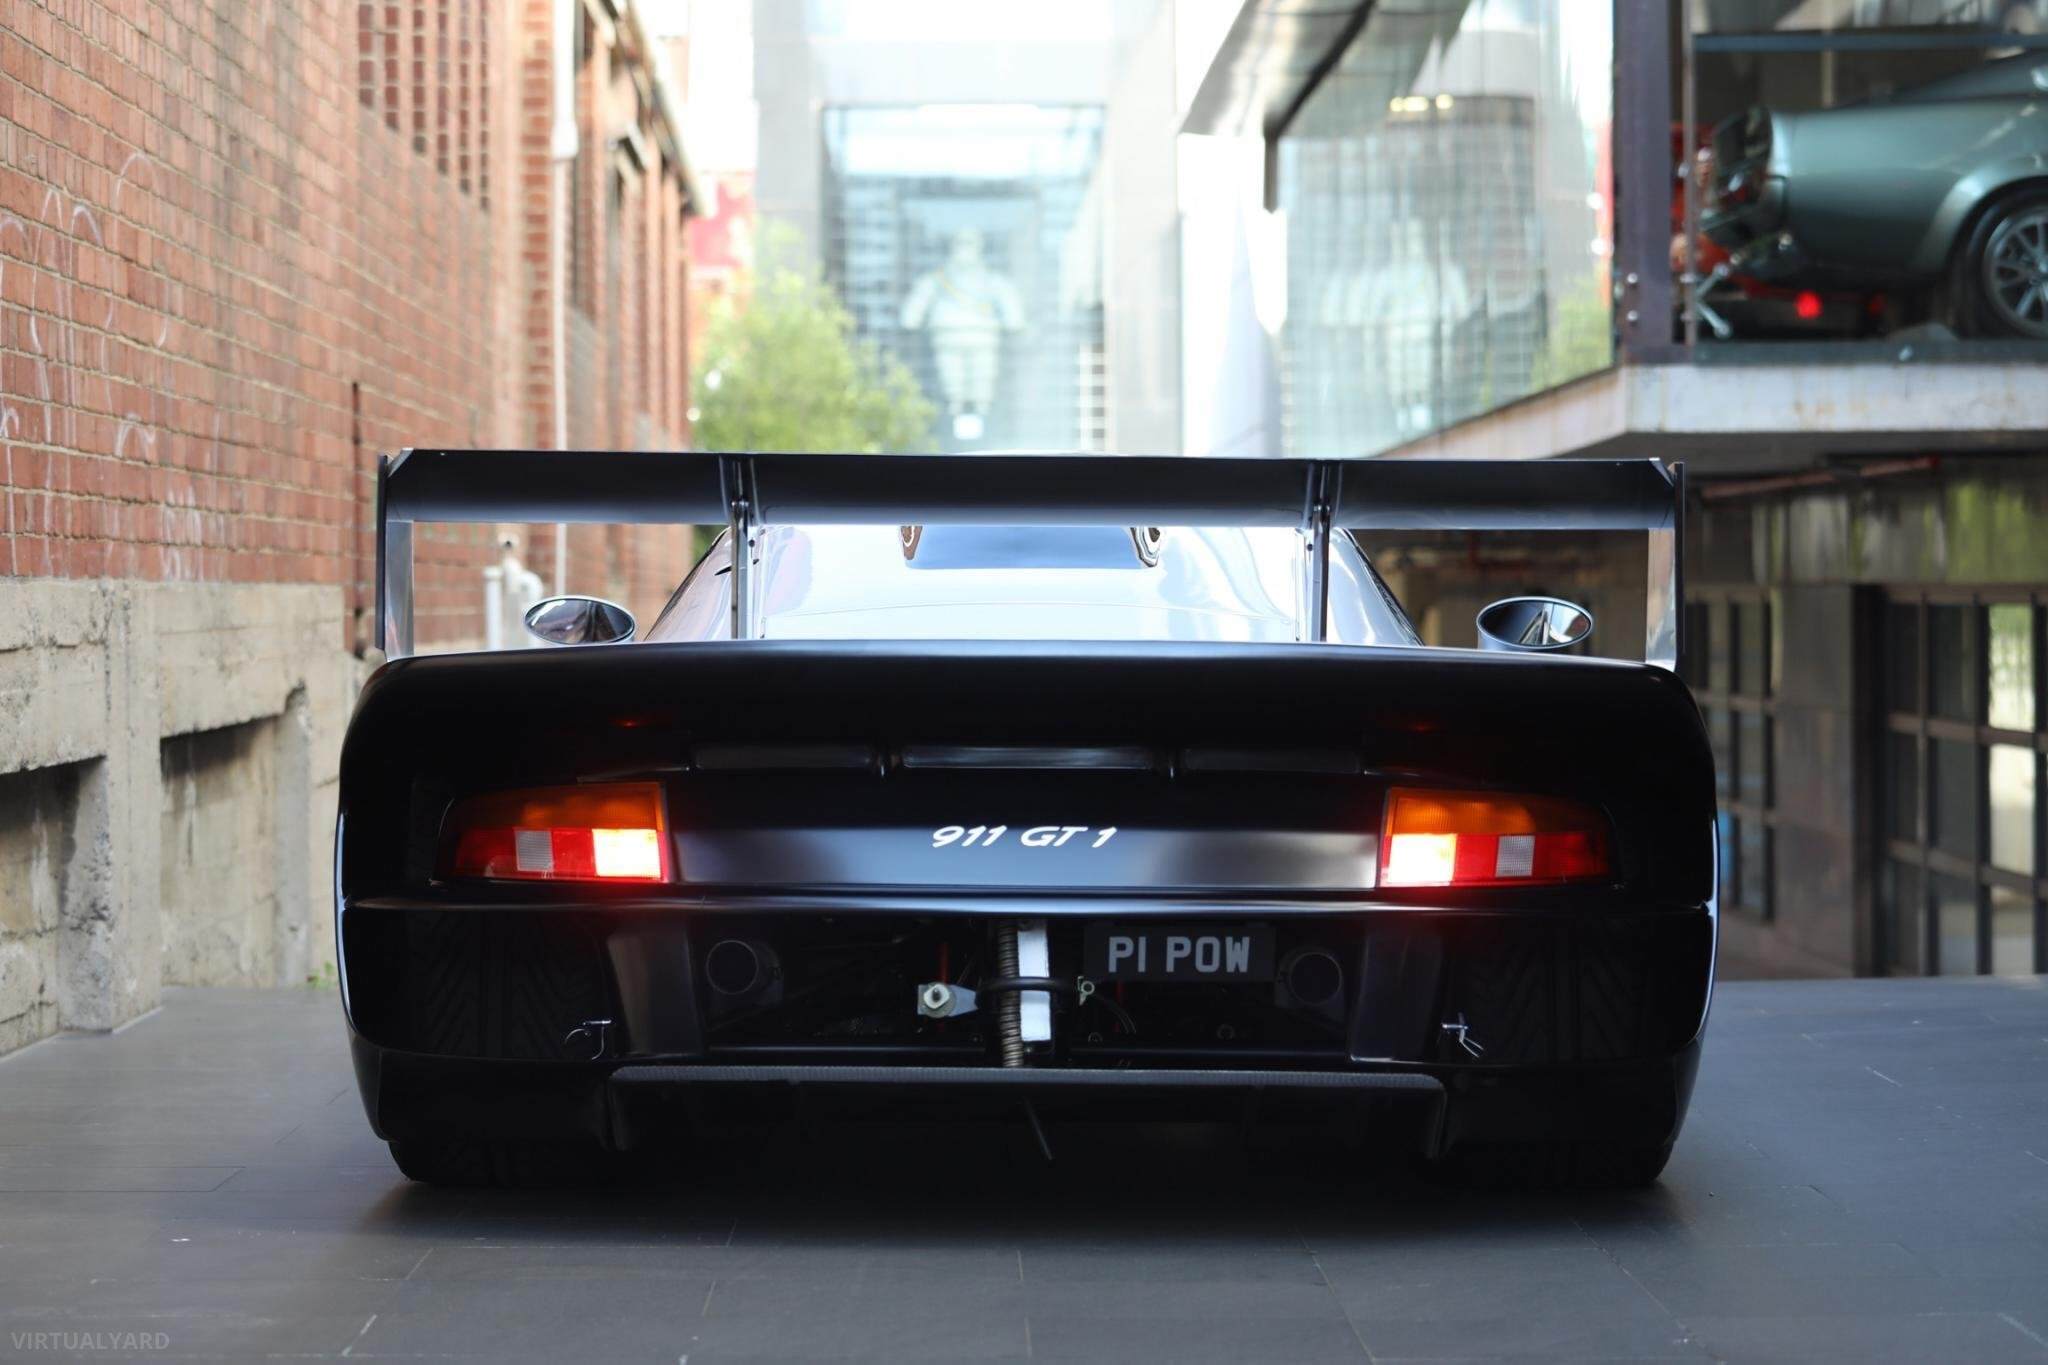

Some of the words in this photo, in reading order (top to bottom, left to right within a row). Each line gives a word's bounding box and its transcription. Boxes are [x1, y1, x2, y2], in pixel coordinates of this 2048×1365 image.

[932, 825, 1007, 848] 911
[1020, 826, 1088, 847] GT
[1092, 827, 1117, 848] 1
[1166, 936, 1250, 973] POW
